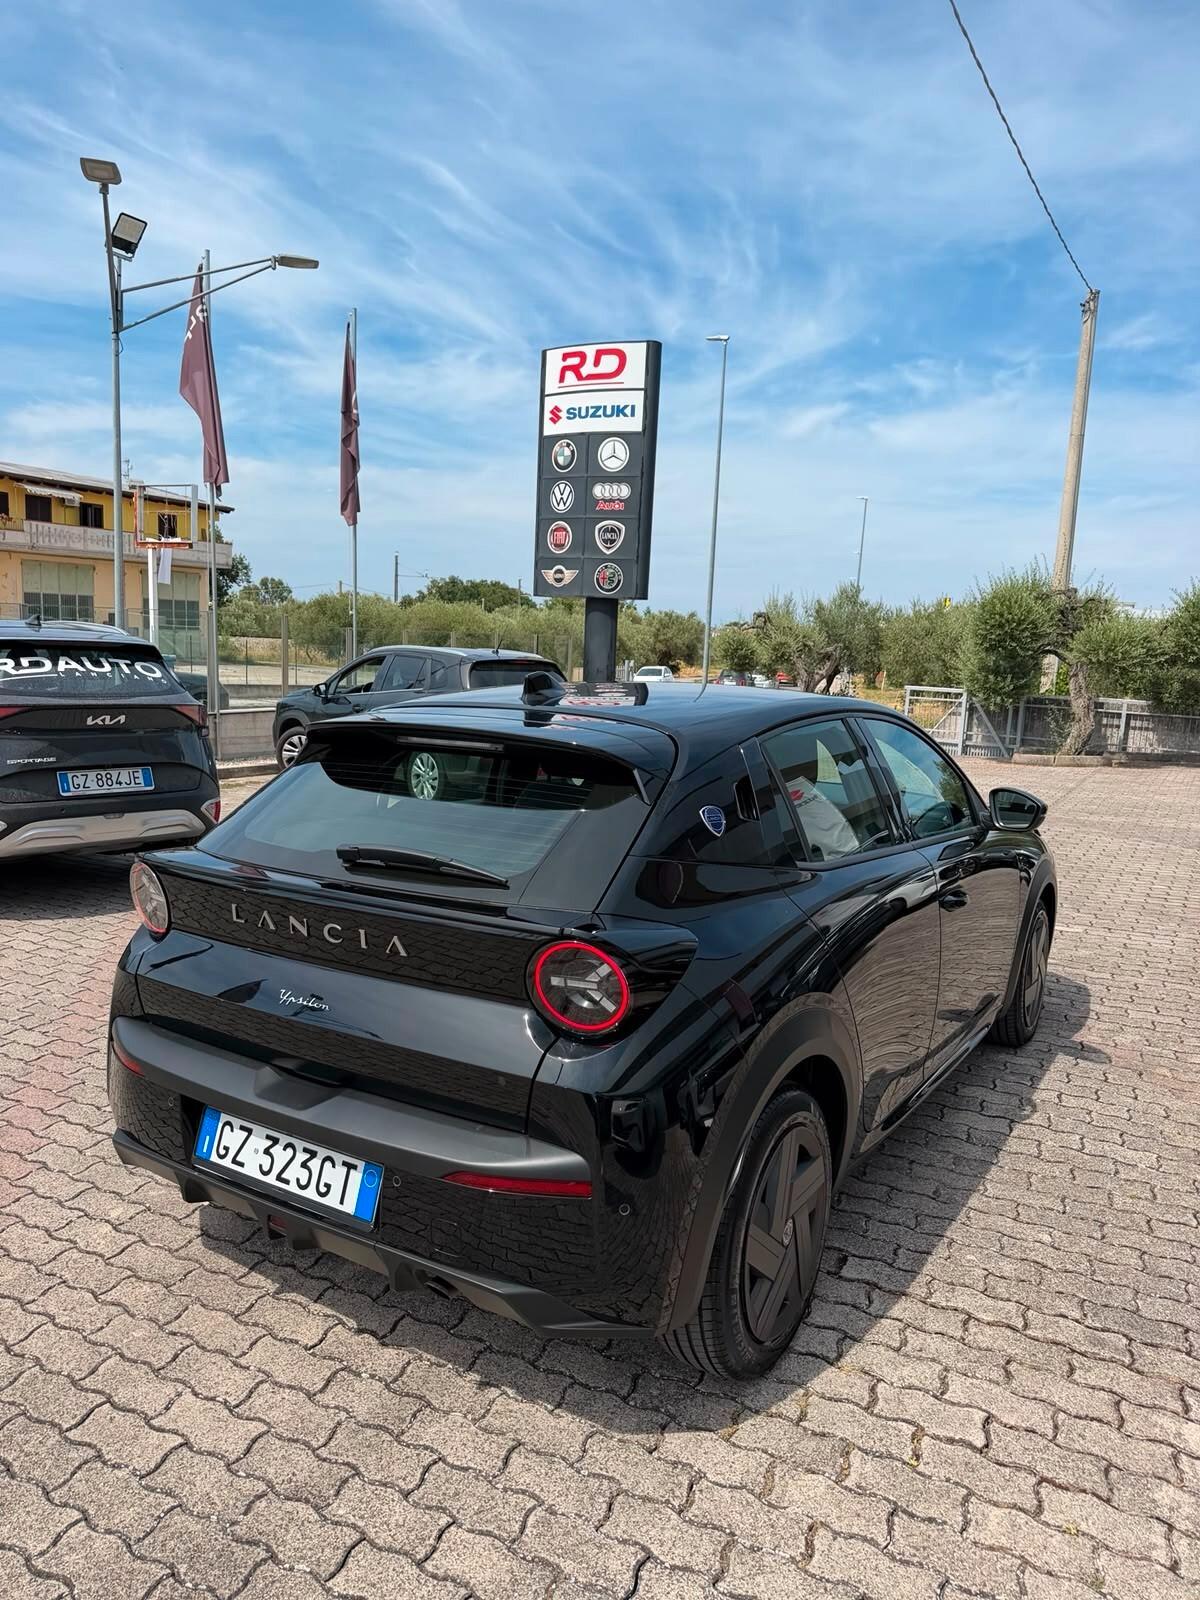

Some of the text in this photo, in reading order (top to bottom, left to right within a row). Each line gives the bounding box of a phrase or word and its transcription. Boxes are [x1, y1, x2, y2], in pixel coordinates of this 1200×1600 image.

[558, 348, 627, 384] RD
[566, 404, 636, 420] SUZUKI
[595, 500, 625, 511] Audi
[86, 714, 126, 725] KIA
[231, 903, 408, 957] LANCIA
[279, 989, 330, 1011] Ypsilon
[215, 1120, 254, 1168] GZ
[258, 1133, 358, 1206] 323GT
